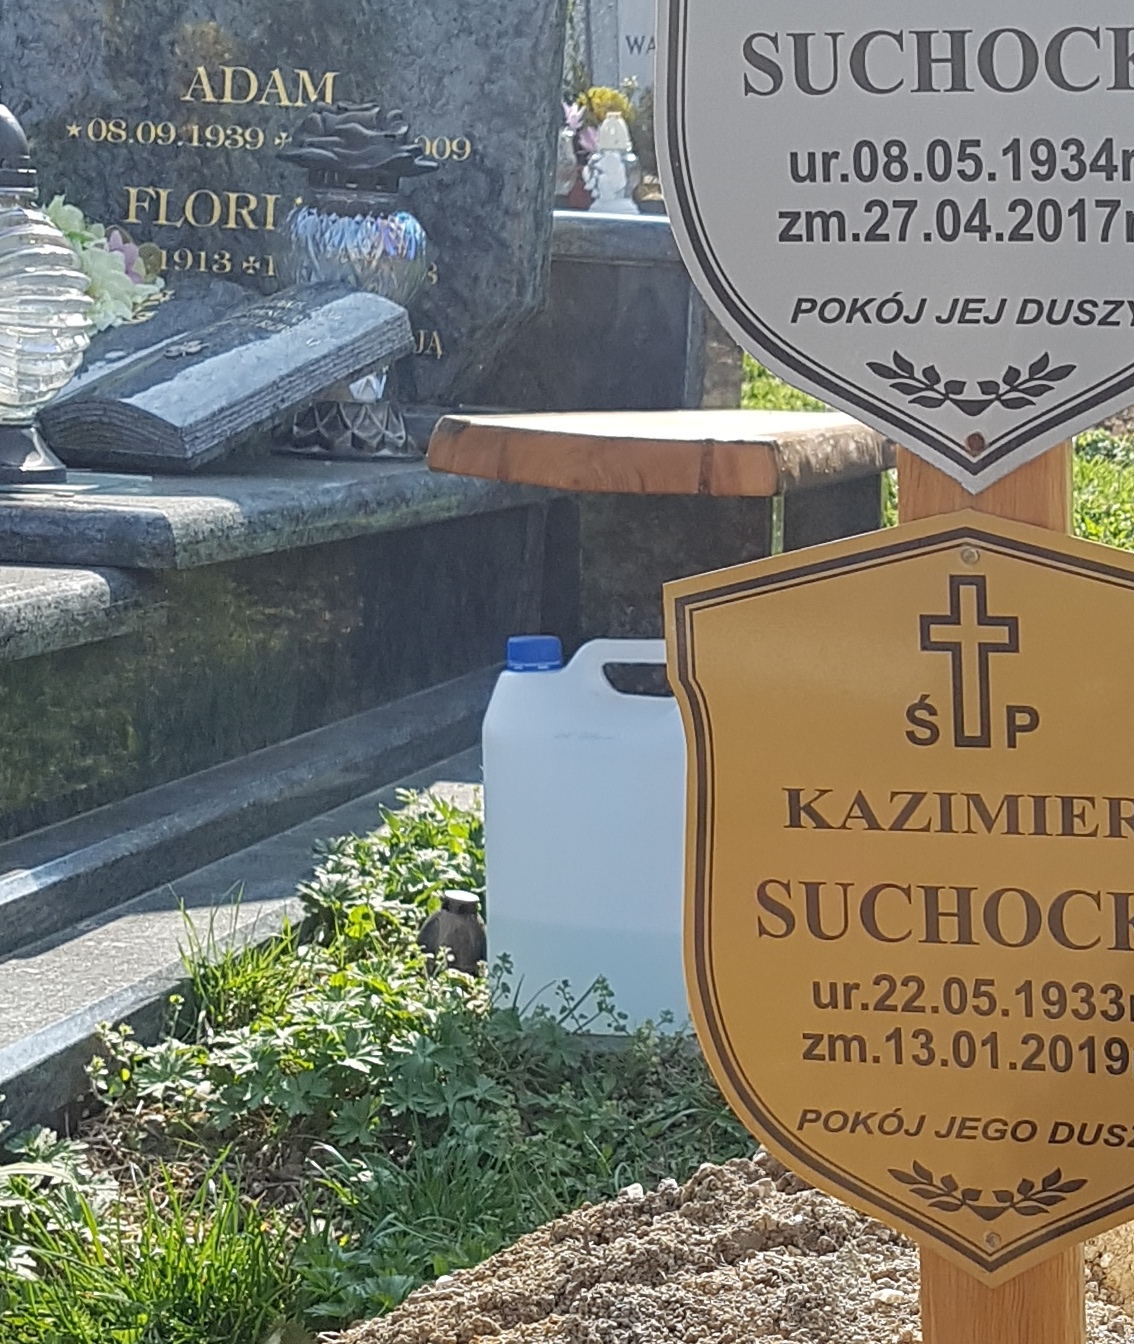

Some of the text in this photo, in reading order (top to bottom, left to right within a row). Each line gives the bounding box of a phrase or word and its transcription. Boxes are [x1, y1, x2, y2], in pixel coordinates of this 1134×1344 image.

[180, 65, 341, 107] ADAM
[122, 185, 282, 232] FLORI
[790, 291, 928, 325] POKÓJ
[935, 297, 1008, 325] JEJ
[905, 694, 1040, 749] Ś P
[796, 1107, 926, 1137] POKÓJ
[934, 1116, 1038, 1144] JEGO
